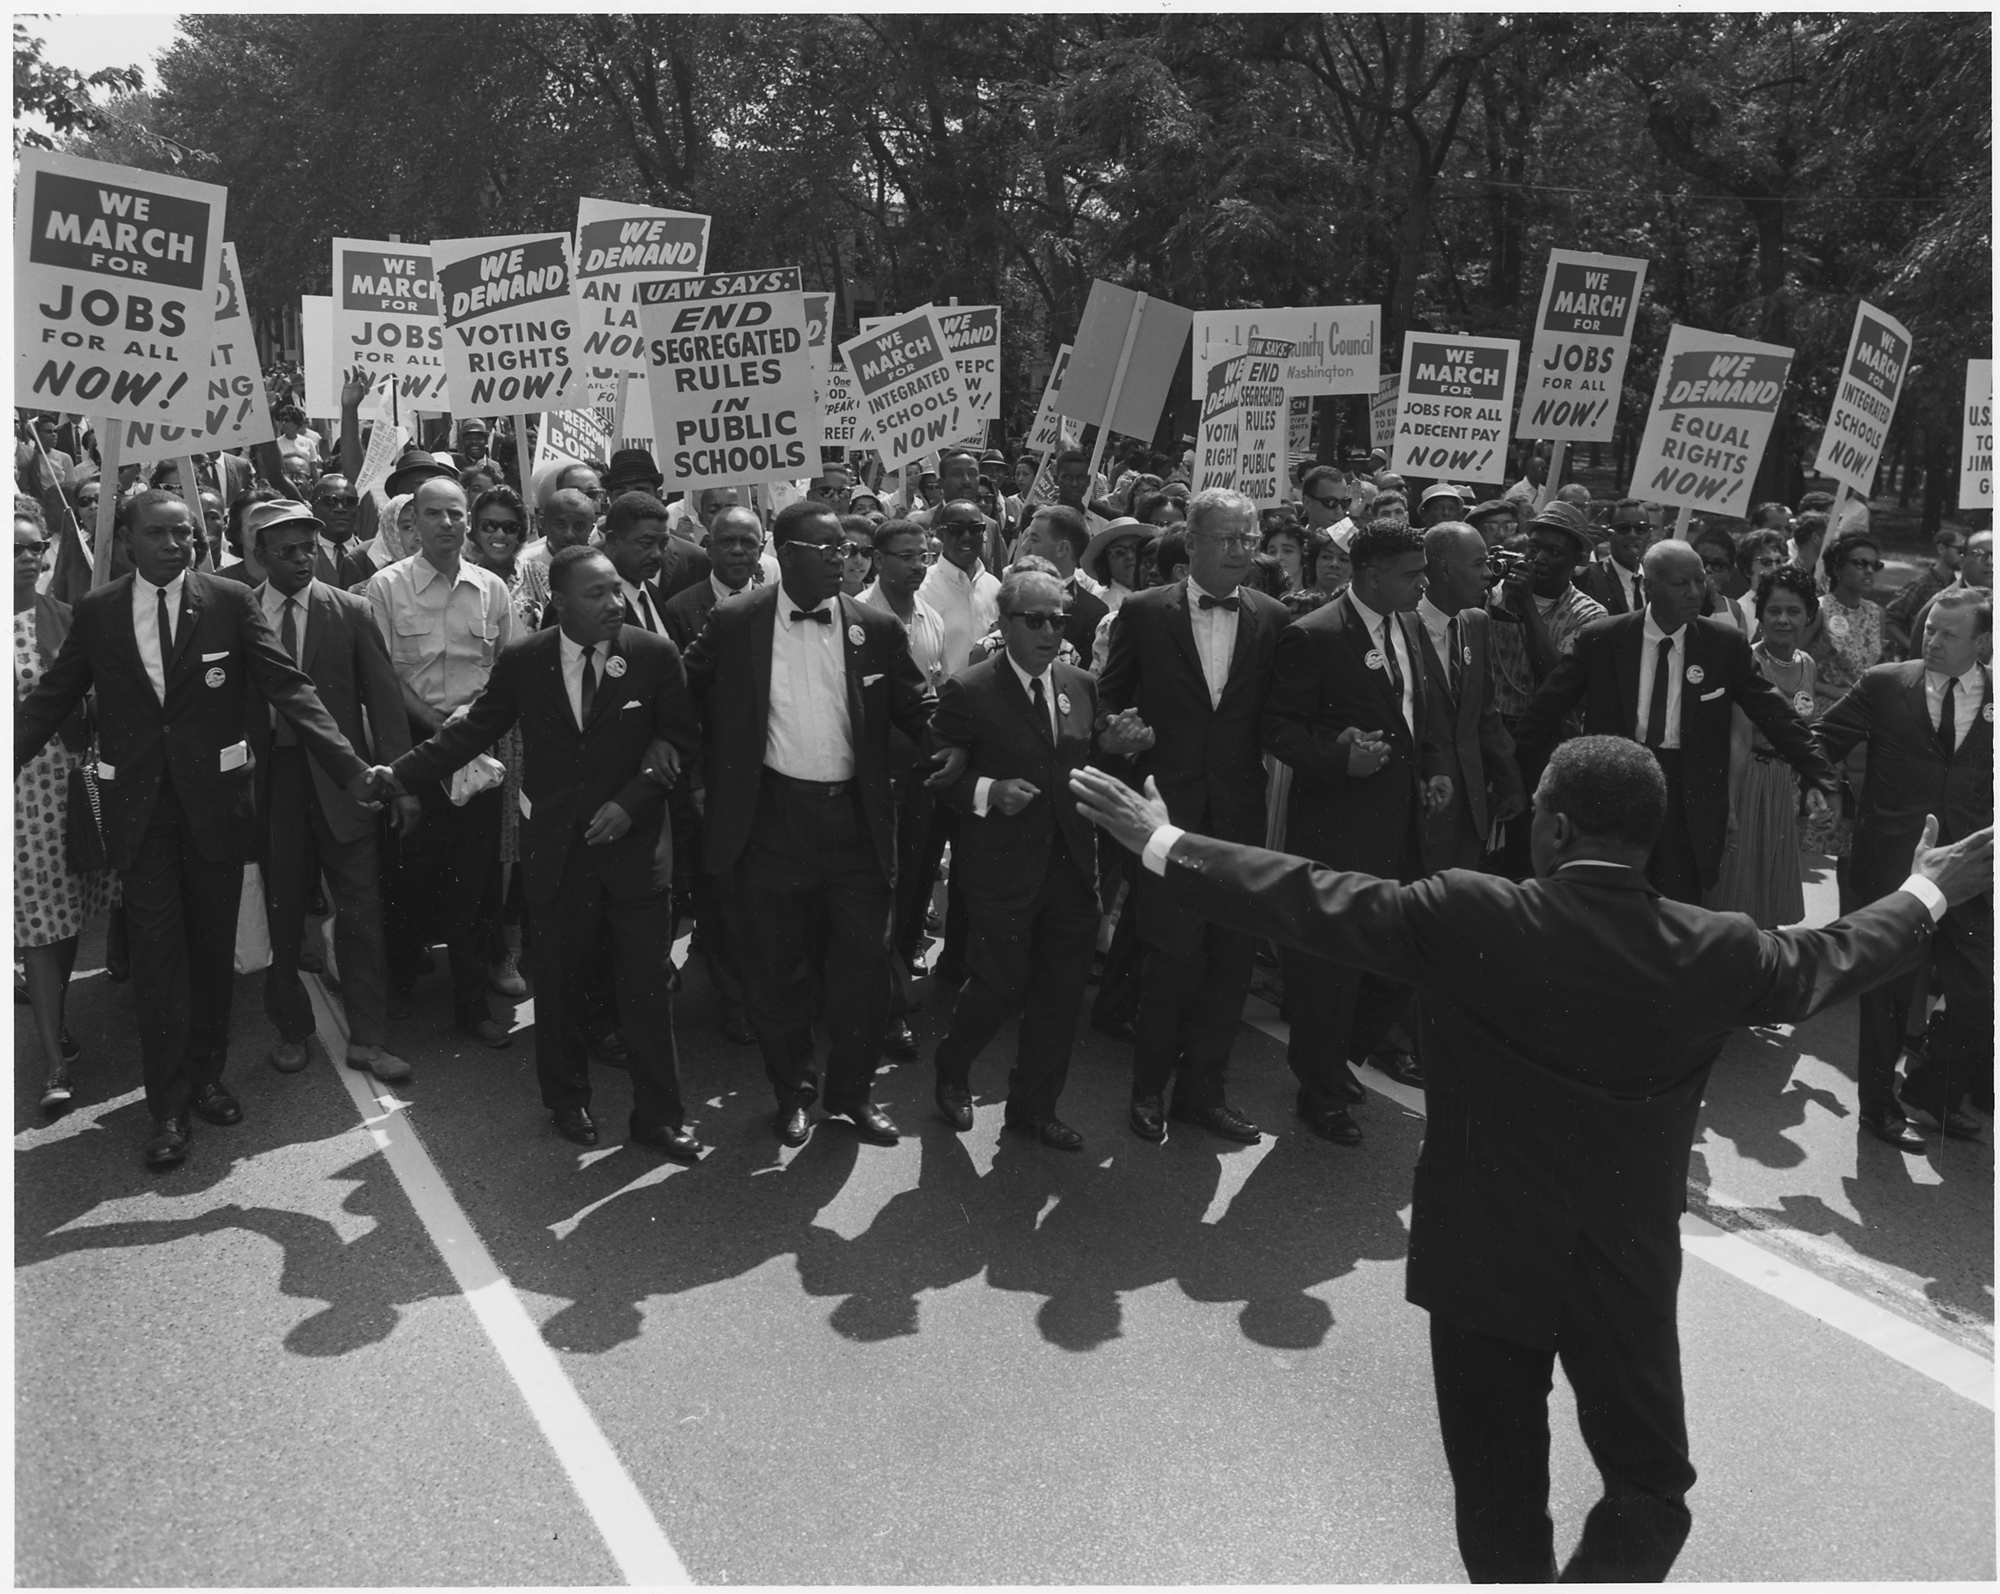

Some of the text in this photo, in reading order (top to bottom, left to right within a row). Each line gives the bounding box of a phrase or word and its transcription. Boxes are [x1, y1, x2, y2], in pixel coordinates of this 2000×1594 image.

[98, 189, 150, 222] WE
[45, 210, 194, 264] MARCH
[620, 220, 666, 244] WE
[91, 253, 148, 276] FOR
[383, 258, 416, 276] WE
[480, 248, 524, 282] WE
[585, 242, 697, 272] DEMAND
[452, 265, 564, 318] DEMAND
[582, 281, 621, 302] AN
[647, 280, 706, 301] UAW
[711, 272, 794, 295] SAYS:
[1586, 272, 1609, 290] WE
[39, 284, 186, 337] JOBS
[382, 300, 418, 312] FOR
[1554, 290, 1626, 318] MARCH
[604, 308, 638, 328] LA
[670, 301, 772, 334] END
[944, 314, 972, 334] WE
[1574, 318, 1600, 330] FOR
[352, 322, 443, 350] JOBS
[456, 319, 570, 346] VOTING
[876, 332, 904, 352] WE
[946, 326, 994, 348] MAND
[1330, 320, 1374, 356] Council
[1880, 331, 1896, 354] WE
[42, 328, 179, 362] FOR ALL
[650, 327, 801, 366] SEGREGATED
[1446, 348, 1474, 364] WE
[354, 351, 442, 366] FOR ALL
[468, 346, 569, 372] RIGHTS
[862, 336, 932, 380] MARCH
[956, 359, 994, 374] FEPC
[1544, 344, 1614, 374] JOBS
[1708, 354, 1756, 378] WE
[1857, 342, 1900, 384] MARCH
[675, 359, 782, 392] RULES
[888, 363, 916, 380] FOR
[1248, 362, 1279, 382] END
[1416, 363, 1500, 386] MARCH
[1868, 372, 1885, 390] FOR
[33, 359, 188, 409] NOW!
[471, 367, 573, 404] NOW!
[868, 366, 950, 414] INTEGRATED
[1440, 385, 1472, 396] FOR
[1542, 377, 1606, 392] FOR ALL
[1669, 380, 1778, 404] DEMAND
[597, 392, 618, 402] FO
[711, 397, 750, 414] IN
[1206, 380, 1240, 415] DEMA
[1240, 386, 1284, 407] SEGREGATED
[1842, 382, 1890, 425] INTEGRATED
[840, 416, 857, 425] FO
[876, 387, 958, 434] SCHOOLS
[1044, 415, 1056, 424] FO
[1246, 410, 1276, 431] RULES
[1374, 408, 1397, 418] AN EN
[1404, 402, 1502, 422] JOBS FOR ALL
[1532, 398, 1608, 428] NOW!
[1969, 406, 1992, 426] U.S.
[559, 410, 604, 449] FREEDOM
[676, 410, 797, 446] PUBLIC
[894, 406, 959, 458] NOW!
[1206, 424, 1238, 442] VOTIN
[1376, 420, 1386, 428] TO
[1400, 422, 1500, 442] A DECENT PAY
[1670, 412, 1750, 450] EQUAL
[1834, 410, 1882, 450] SCHOOLS
[563, 422, 595, 452] WE ARE
[960, 436, 982, 445] RAVE
[1254, 439, 1265, 450] IN
[1976, 435, 1993, 451] TO
[674, 441, 806, 478] SCHOOLS
[1205, 448, 1237, 466] RIGHT
[1242, 452, 1276, 475] PUBLIC
[1406, 446, 1494, 472] NOW!
[1662, 438, 1748, 474] RIGHTS
[1828, 440, 1874, 478] NOW!
[1966, 455, 1993, 472] JIM
[1240, 478, 1276, 500] SCHOOLS
[1650, 466, 1744, 504] NOW!
